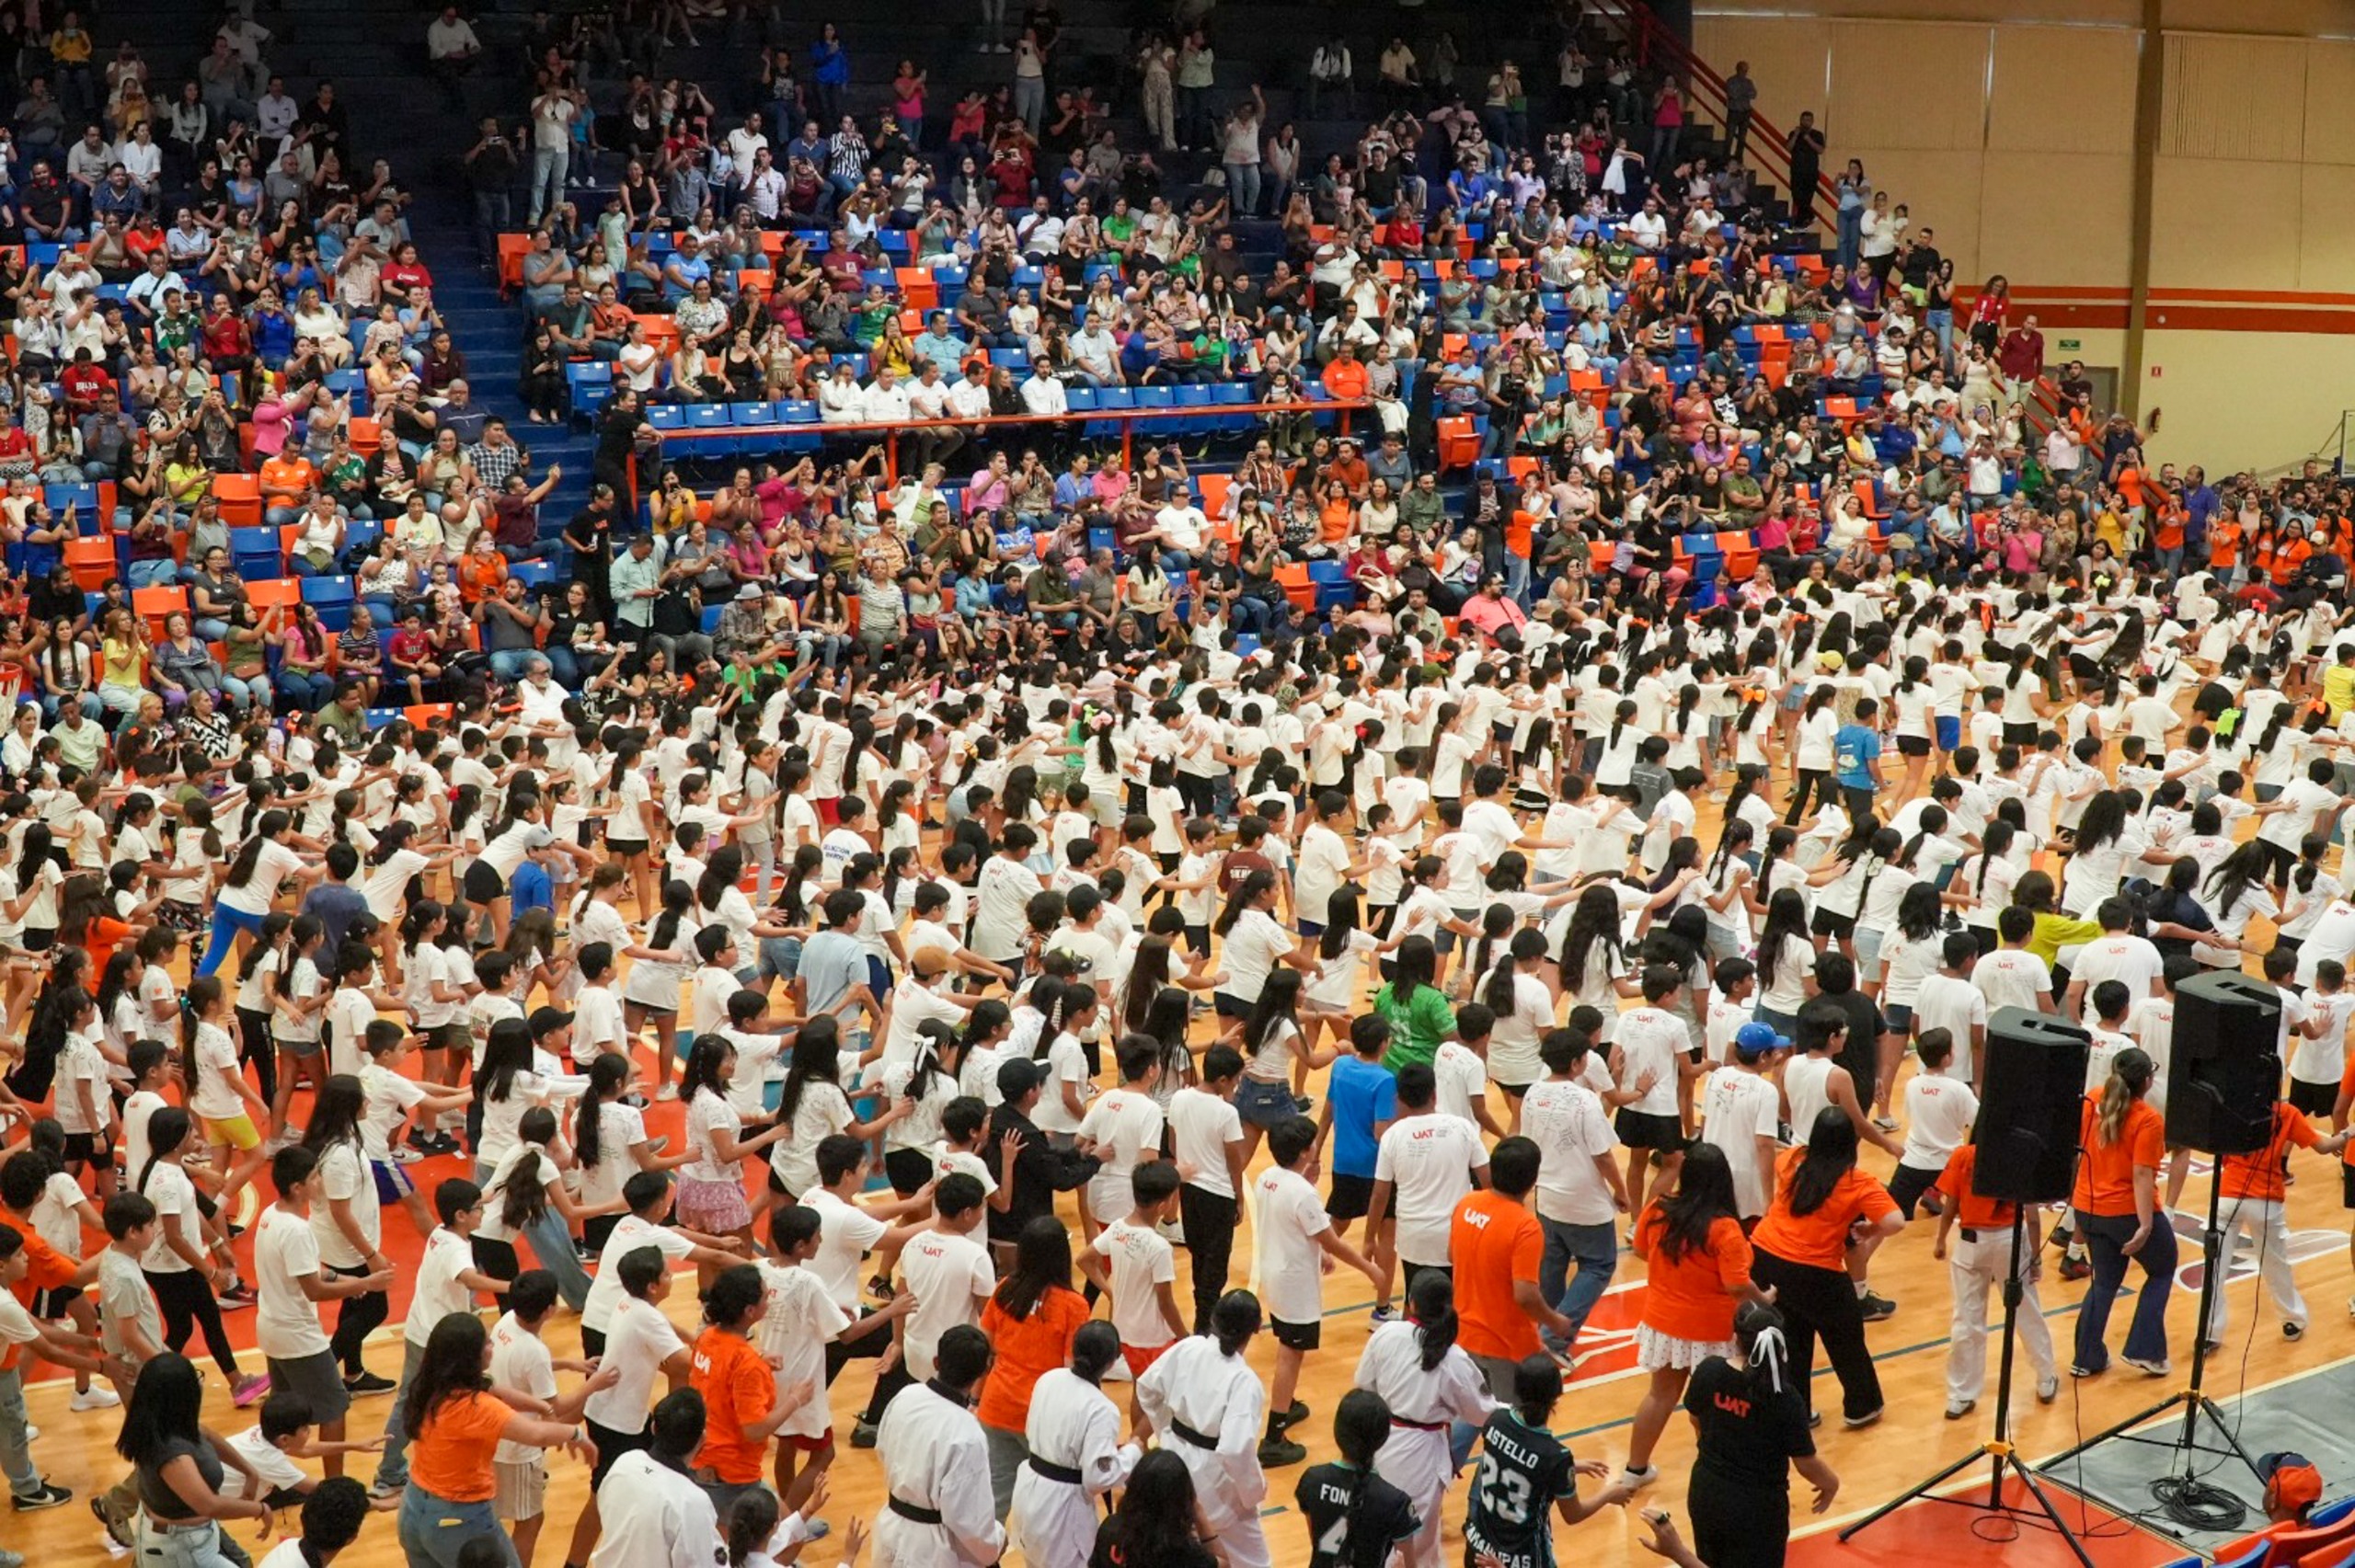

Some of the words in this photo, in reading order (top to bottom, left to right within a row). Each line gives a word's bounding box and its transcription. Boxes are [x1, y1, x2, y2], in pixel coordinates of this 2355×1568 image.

[2108, 946, 2127, 955] UAT
[1998, 961, 2014, 969] UAT
[2313, 1001, 2330, 1011] UAT
[1637, 1014, 1655, 1024] UAT
[1922, 1087, 1940, 1095] UAT
[1412, 1128, 1434, 1139] UAT
[1464, 1207, 1490, 1230] UAT
[923, 1246, 945, 1258] UAT
[1713, 1391, 1752, 1417] UAT
[1486, 1426, 1539, 1469] ASTELLO
[1481, 1450, 1532, 1524] 23
[1320, 1483, 1350, 1505] FON
